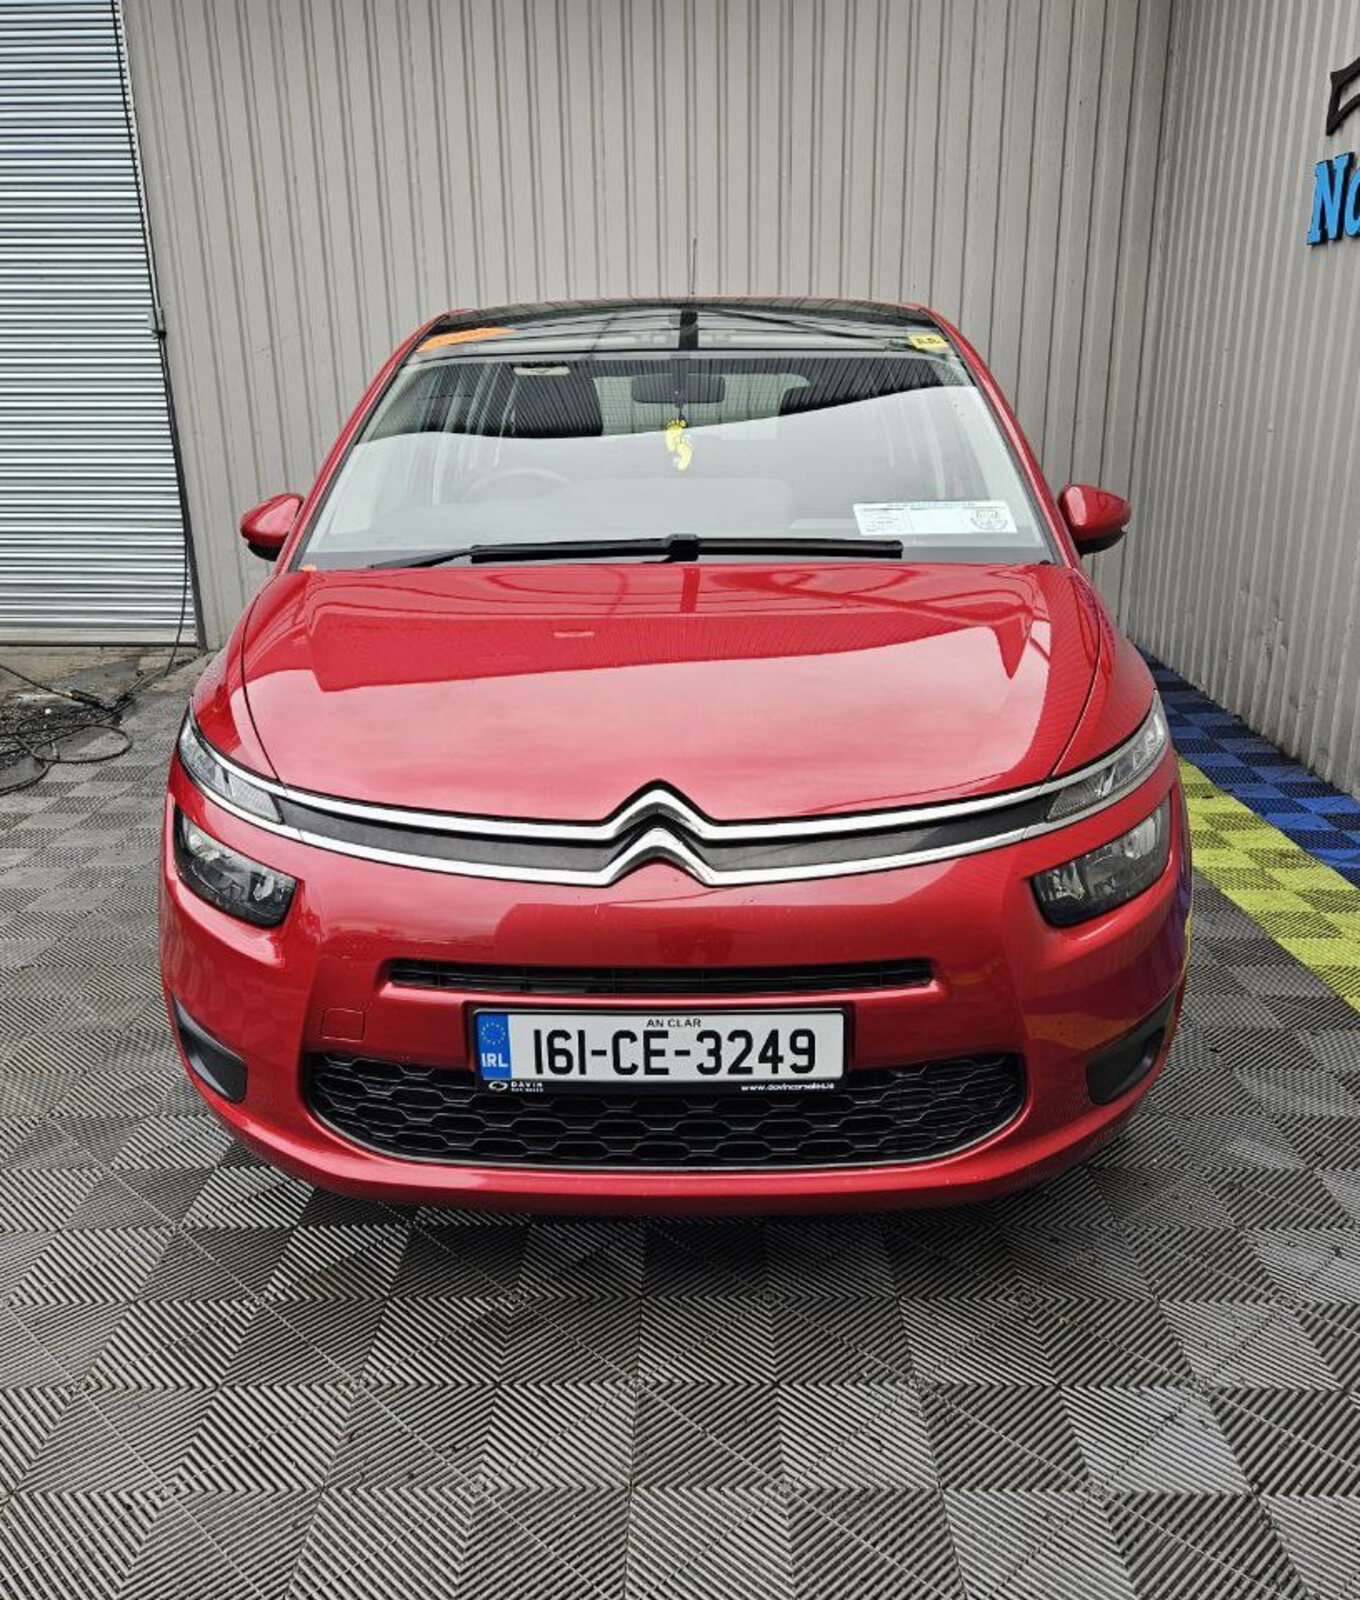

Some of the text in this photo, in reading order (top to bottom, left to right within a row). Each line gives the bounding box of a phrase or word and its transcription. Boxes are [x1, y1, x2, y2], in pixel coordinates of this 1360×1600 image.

[646, 1018, 701, 1028] AN CLAR
[533, 1029, 816, 1075] 161-CE-3249
[481, 1054, 508, 1067] IRL
